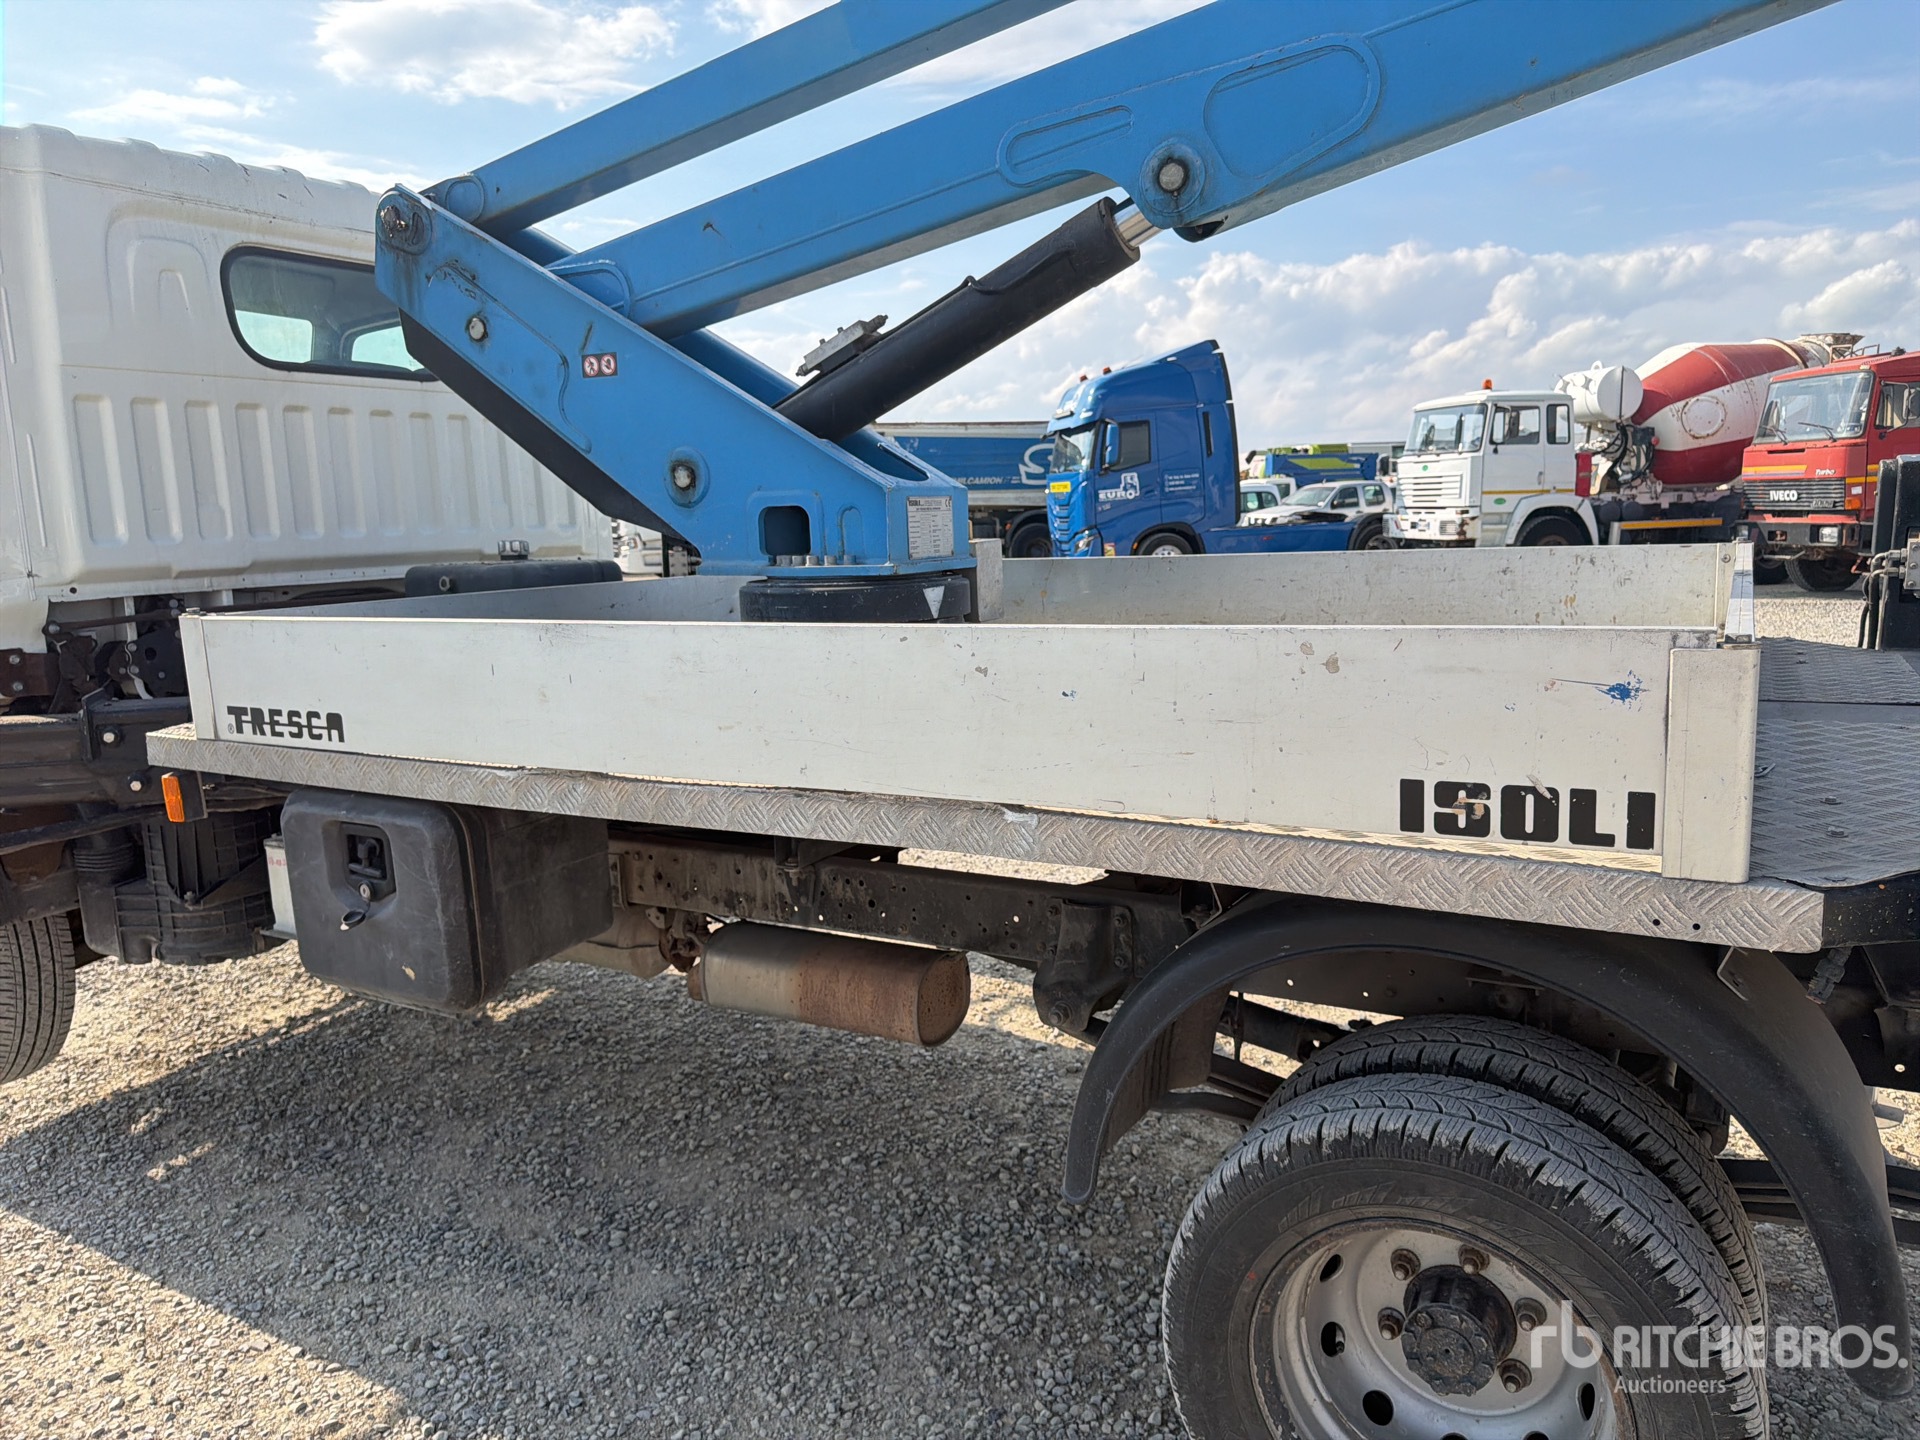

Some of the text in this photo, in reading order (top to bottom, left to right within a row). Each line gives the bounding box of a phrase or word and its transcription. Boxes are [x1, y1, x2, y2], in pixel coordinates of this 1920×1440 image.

[1769, 490, 1798, 501] IVECO
[227, 705, 345, 743] TRESCA
[1400, 778, 1656, 850] ISOLI
